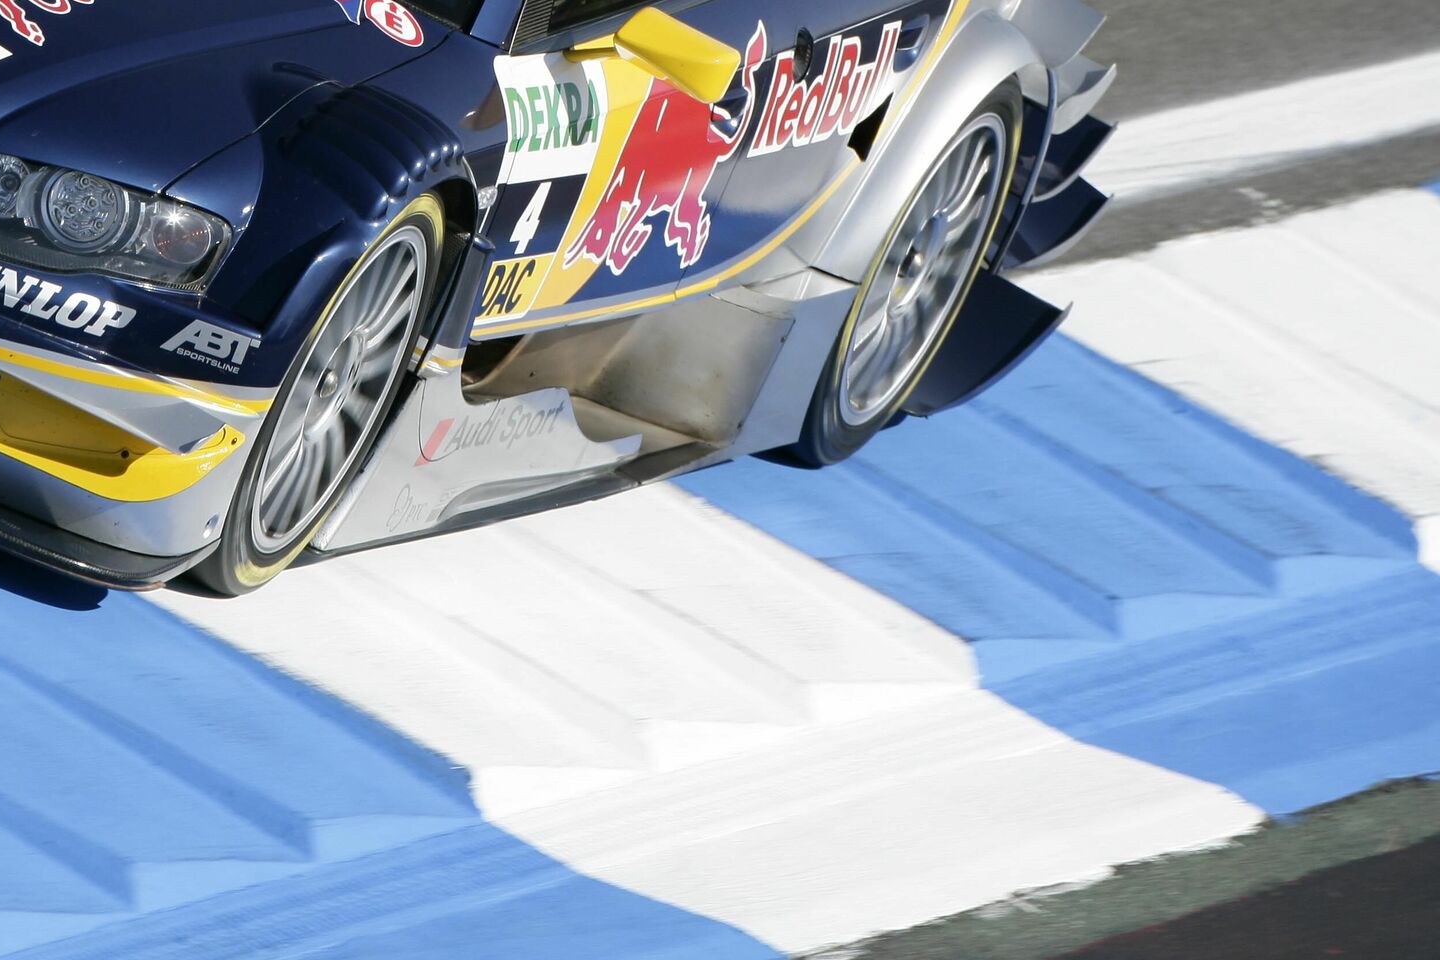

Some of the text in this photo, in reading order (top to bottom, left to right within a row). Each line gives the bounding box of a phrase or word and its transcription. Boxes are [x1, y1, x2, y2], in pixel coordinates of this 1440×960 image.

[384, 11, 404, 35] E
[504, 78, 601, 153] DEKRA
[750, 24, 899, 152] Red Bull
[509, 180, 553, 255] 4
[475, 258, 537, 318] DAC
[160, 319, 261, 366] ABT
[176, 347, 241, 375] SPORTSLINE
[443, 400, 565, 452] Audi Sport
